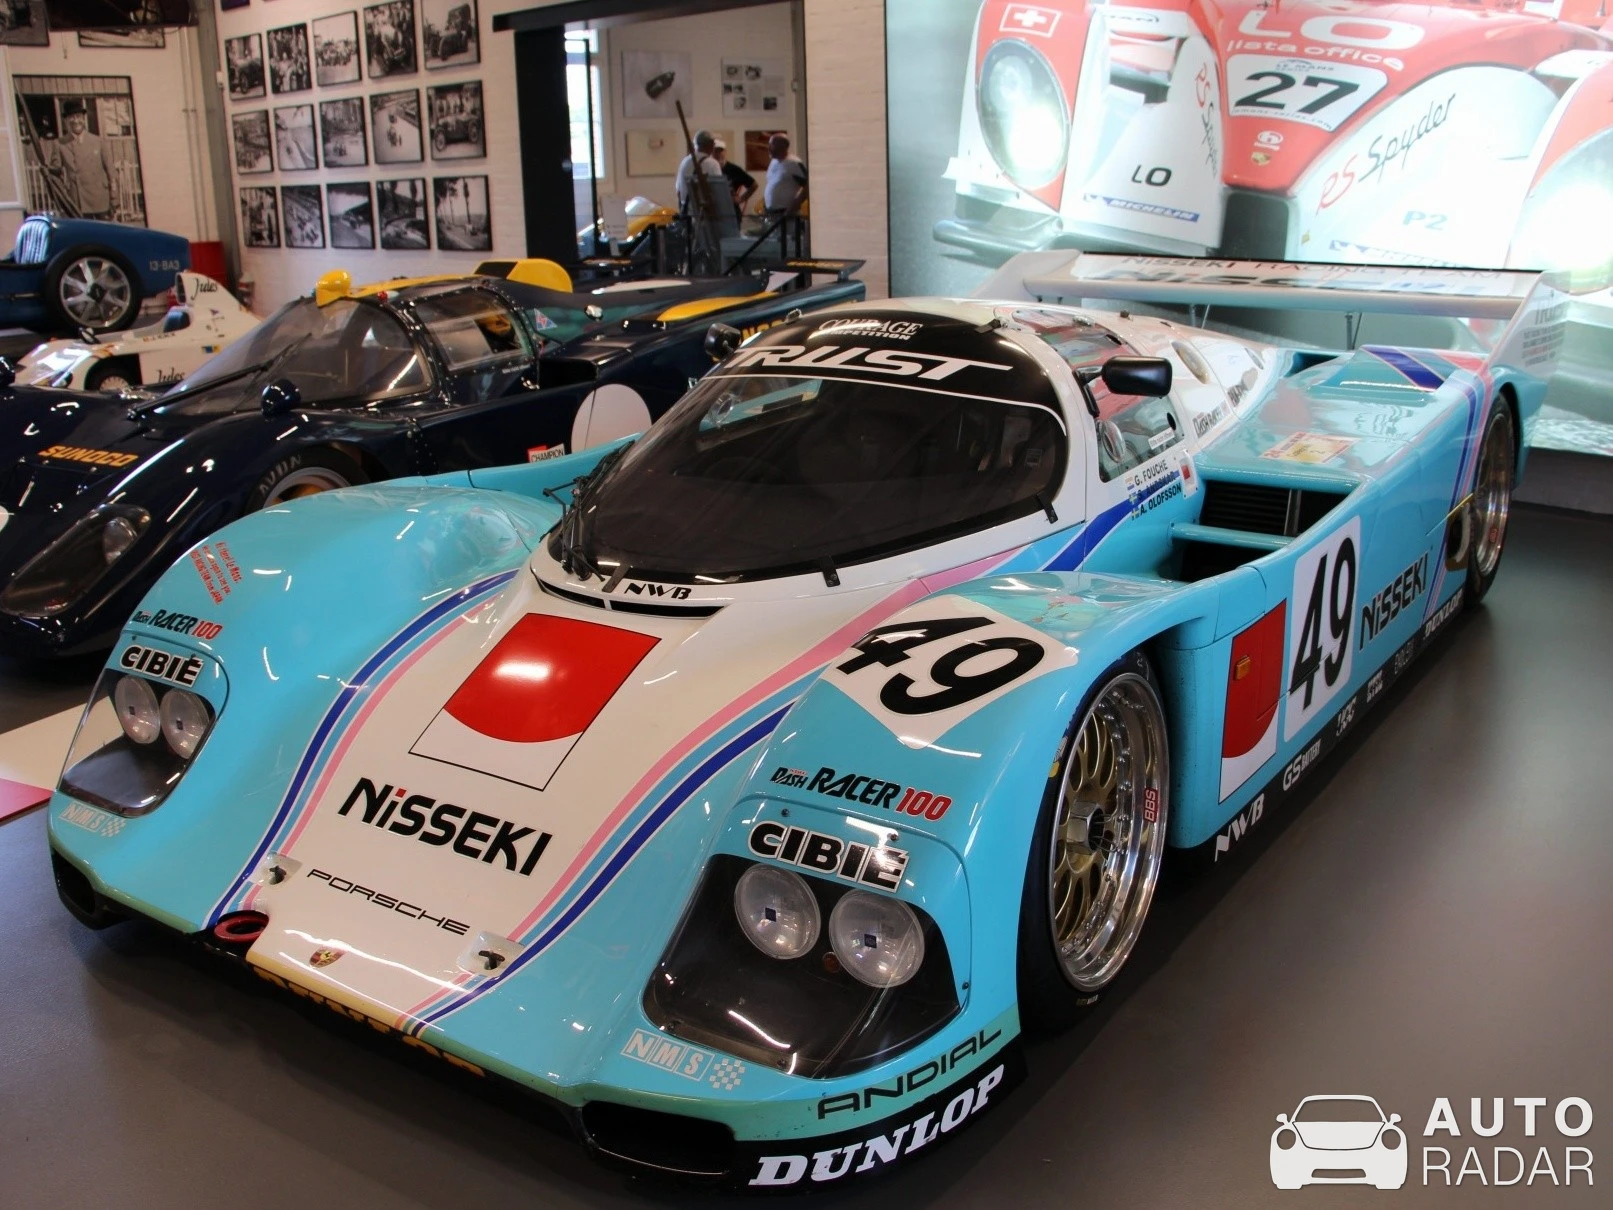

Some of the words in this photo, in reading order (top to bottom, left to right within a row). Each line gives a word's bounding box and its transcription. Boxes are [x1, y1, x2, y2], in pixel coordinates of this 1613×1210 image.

[1226, 40, 1297, 53] lista
[1304, 47, 1405, 72] office
[1234, 71, 1360, 115] 27
[1314, 153, 1358, 217] RS
[1358, 93, 1457, 184] Spyder
[1131, 165, 1173, 187] LO
[1109, 199, 1196, 221] MICHELIN
[1402, 210, 1449, 231] P2
[819, 318, 924, 336] COURAGE
[723, 345, 1014, 382] TRUST
[38, 445, 139, 468] SUNOCO
[531, 448, 566, 463] CHAMPION
[1148, 482, 1182, 511] OLOFSSON
[624, 581, 692, 600] NWB
[148, 608, 199, 635] RACER
[191, 619, 223, 640] 100
[1289, 536, 1357, 711] 49
[836, 616, 1046, 716] 49
[1282, 754, 1303, 792] GS
[769, 766, 808, 789] DASH
[806, 766, 902, 809] RACER
[895, 786, 953, 822] 100
[1144, 789, 1157, 823] BBS
[1214, 793, 1265, 863] NWB
[306, 868, 471, 937] PORSCHE
[625, 1031, 705, 1077] NMS
[816, 1028, 1003, 1121] ANDIAL
[748, 1064, 1006, 1188] DUNLOP
